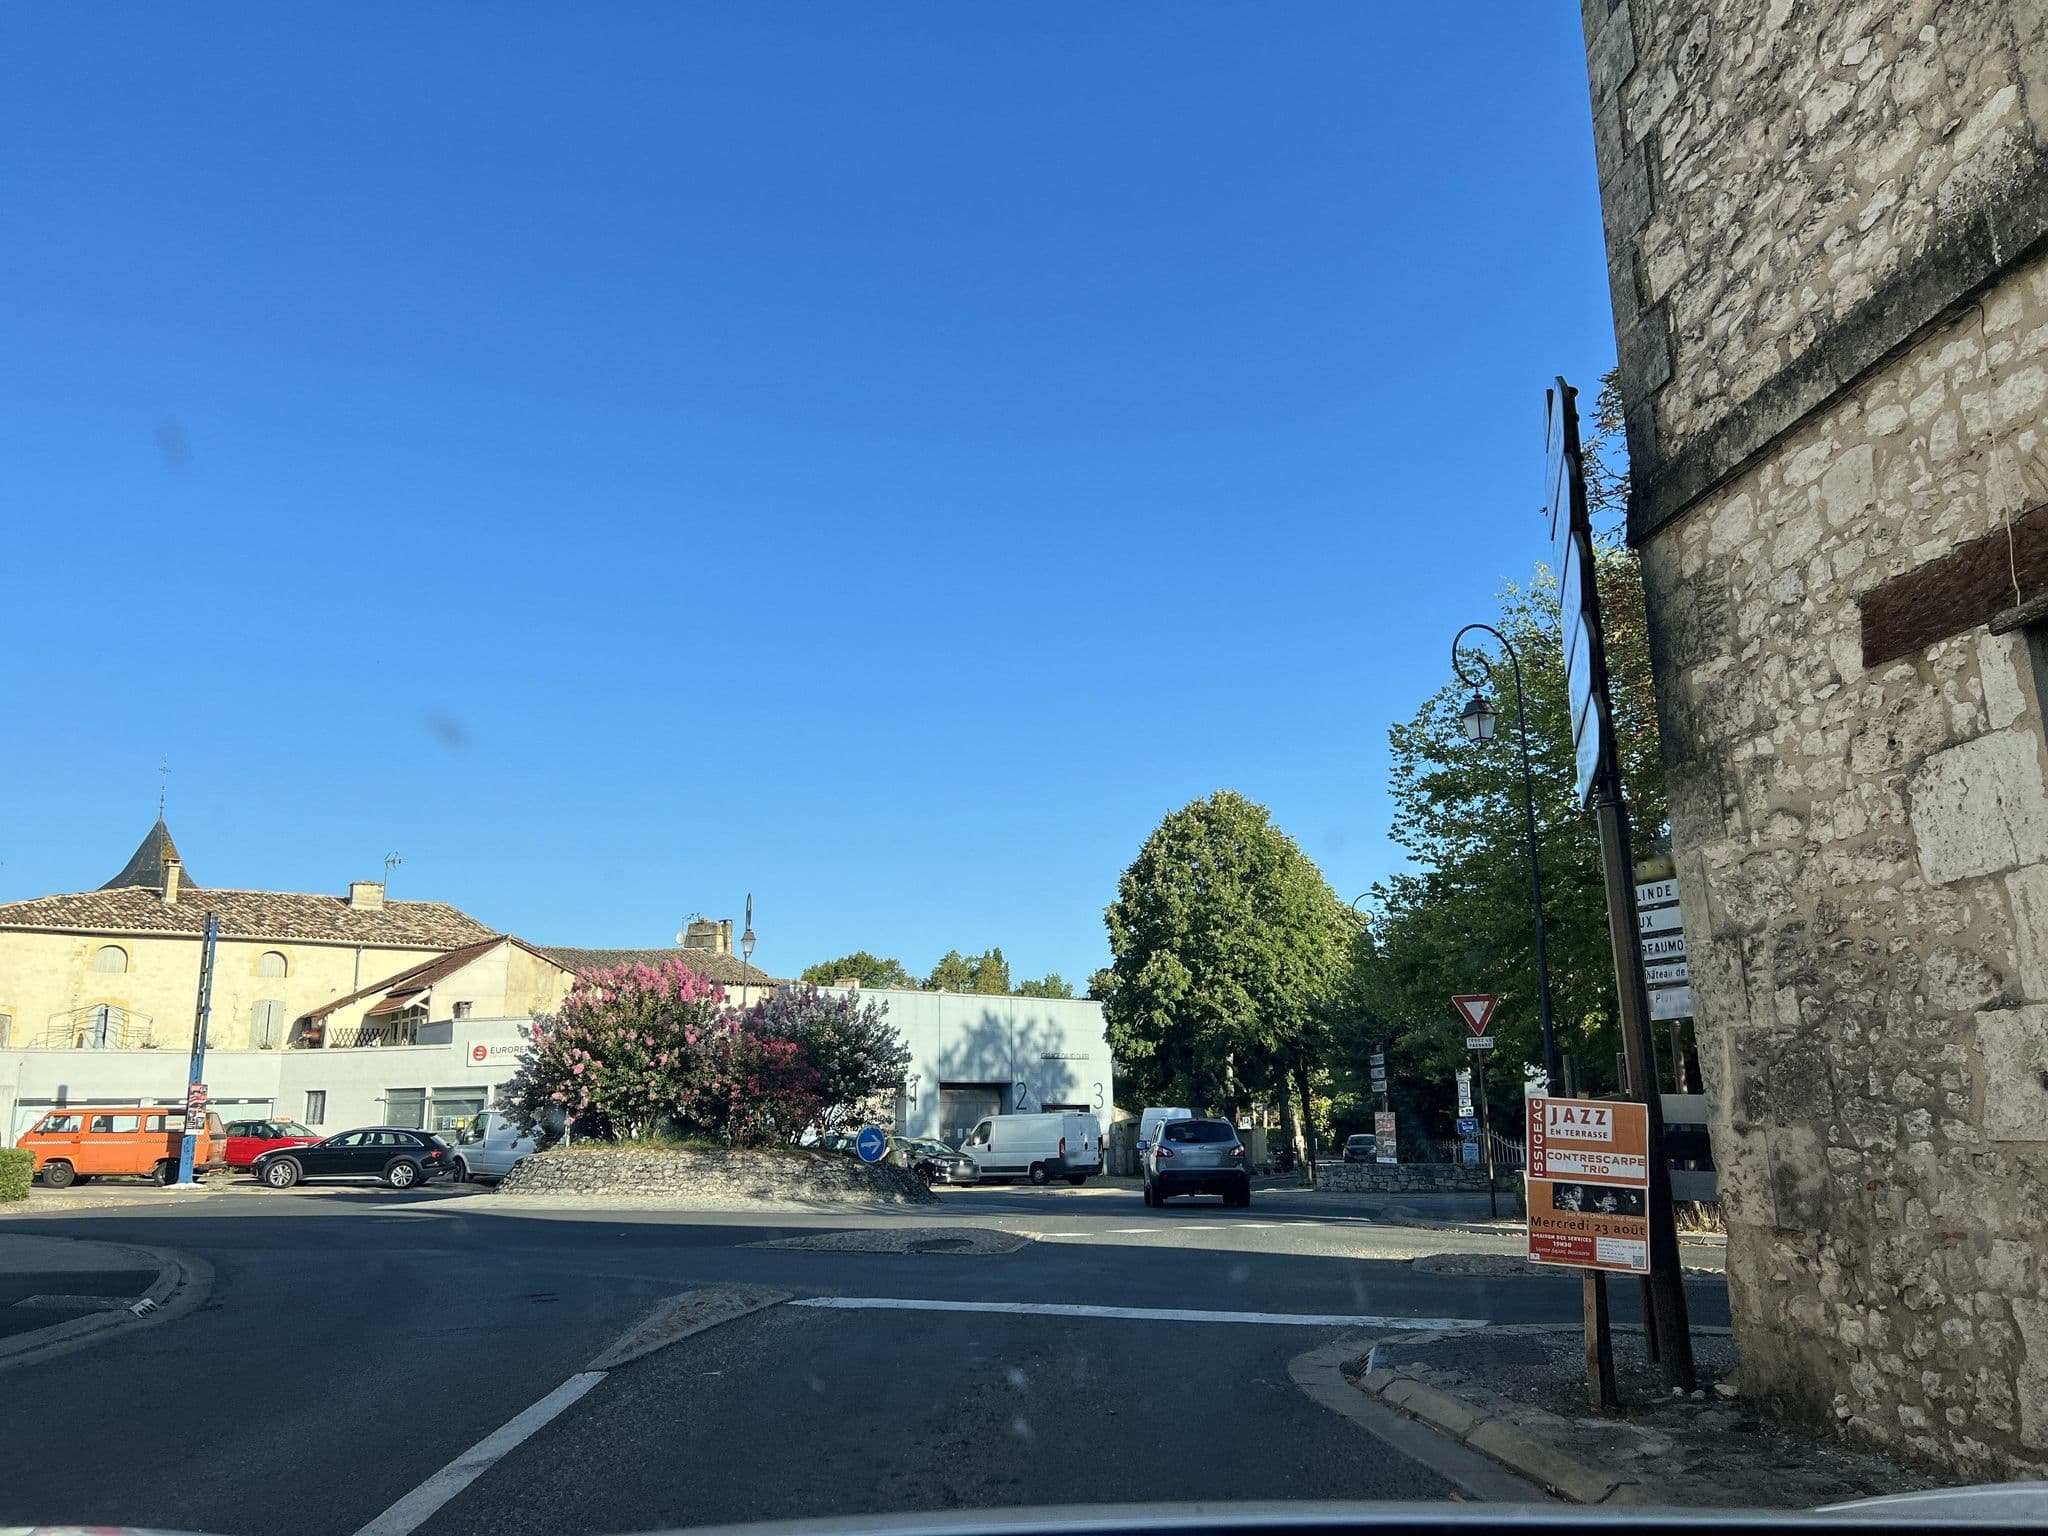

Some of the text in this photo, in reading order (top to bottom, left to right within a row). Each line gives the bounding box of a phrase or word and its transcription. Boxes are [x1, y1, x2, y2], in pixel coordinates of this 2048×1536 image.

[1675, 968, 1686, 977] de
[1015, 1082, 1028, 1111] 2
[1093, 1082, 1104, 1110] 3
[1550, 1107, 1607, 1126] JAZZ
[1532, 1099, 1544, 1177] ISSIGEAC
[1550, 1128, 1608, 1139] EN TERRASSE
[1546, 1151, 1645, 1167] CONTRESCARPE
[1581, 1164, 1609, 1174] TRIO
[1530, 1216, 1590, 1231] Mercredi
[1594, 1224, 1609, 1235] 23
[1613, 1224, 1646, 1236] août
